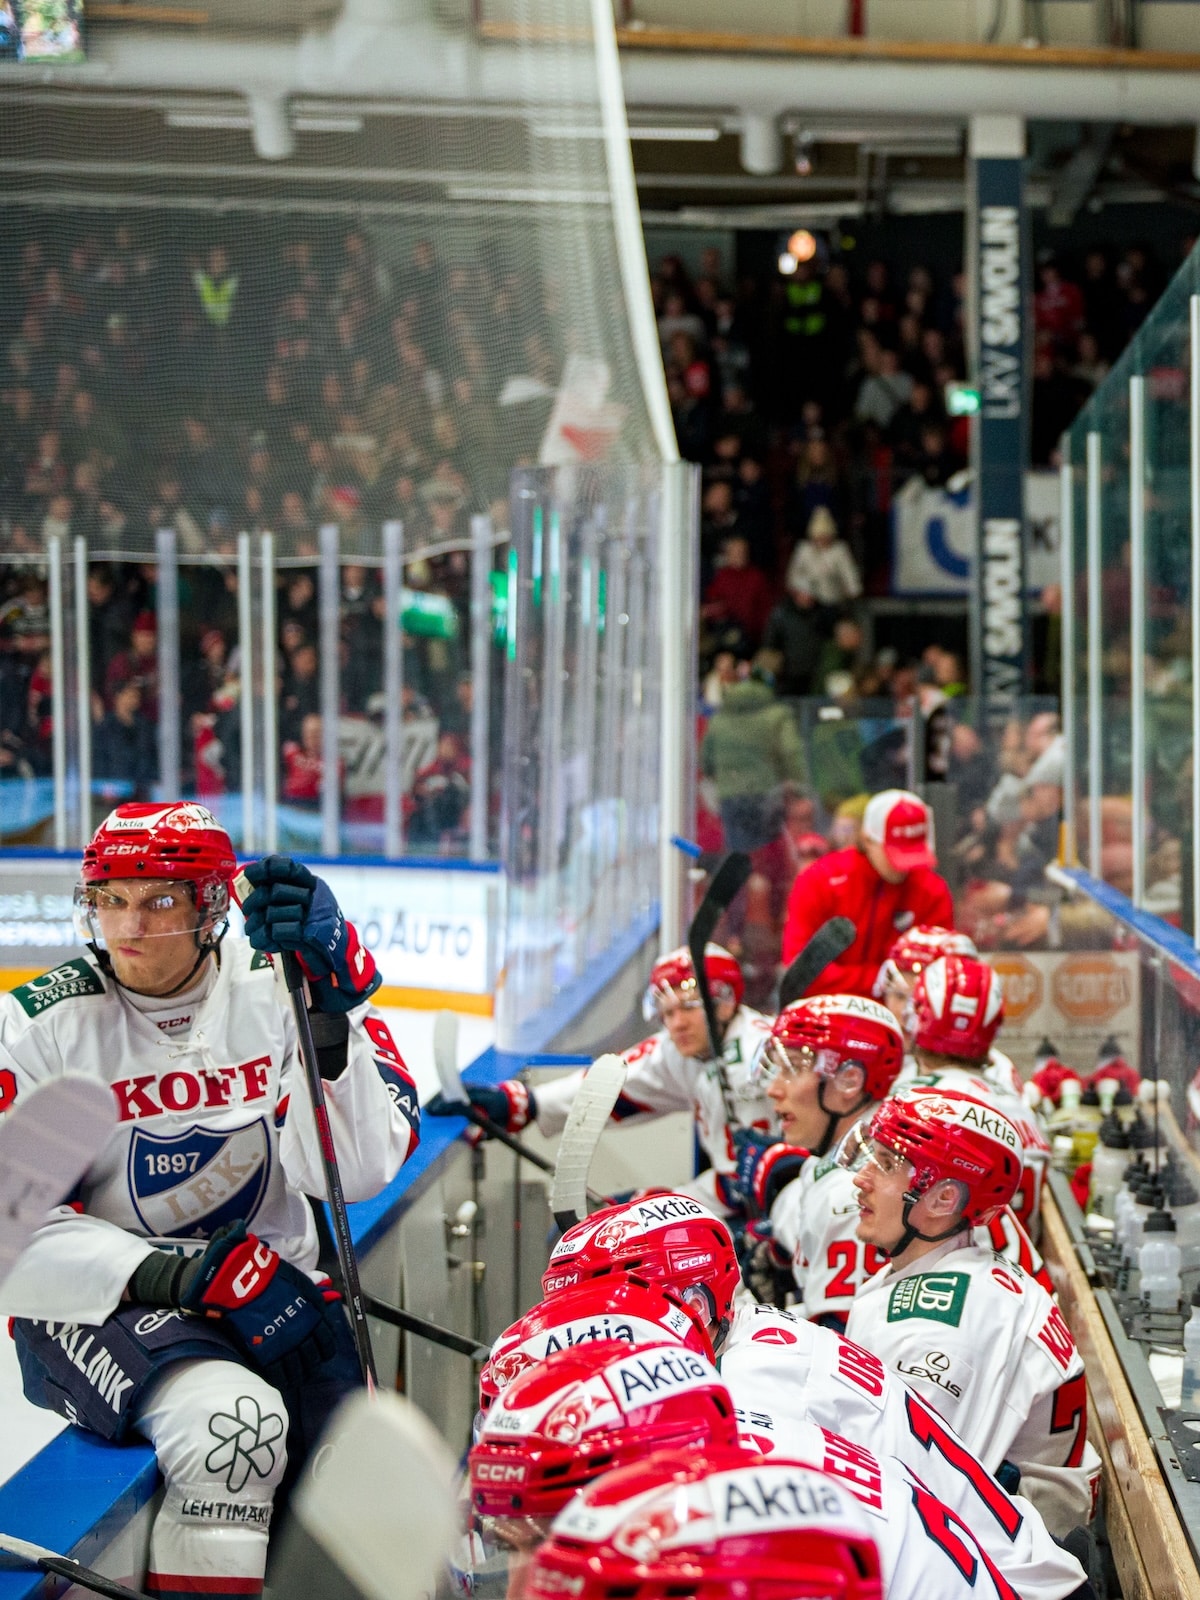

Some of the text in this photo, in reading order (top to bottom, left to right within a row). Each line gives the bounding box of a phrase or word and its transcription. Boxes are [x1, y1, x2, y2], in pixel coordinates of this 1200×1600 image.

[114, 820, 144, 829] Aktia
[103, 844, 150, 856] CCM
[22, 965, 81, 992] UB
[35, 980, 86, 1001] UNITED
[33, 984, 95, 1011] BANKERS
[157, 1014, 191, 1029] CCM
[846, 999, 894, 1024] Aktia
[110, 1055, 272, 1122] KOFF
[962, 1106, 1017, 1148] Aktia
[144, 1151, 201, 1176] 1897
[952, 1157, 986, 1175] CCM
[638, 1198, 703, 1228] Aktia
[554, 1242, 576, 1256] Aktia
[677, 1253, 712, 1270] CCM
[545, 1273, 578, 1292] CCM
[917, 1276, 958, 1312] UB
[264, 1296, 307, 1336] OMEN
[669, 1312, 687, 1332] Aktia
[545, 1318, 635, 1359] Aktia
[620, 1351, 707, 1402] Aktia
[896, 1360, 962, 1399] LEXUS
[476, 1463, 526, 1483] CCM
[724, 1474, 844, 1523] Aktia
